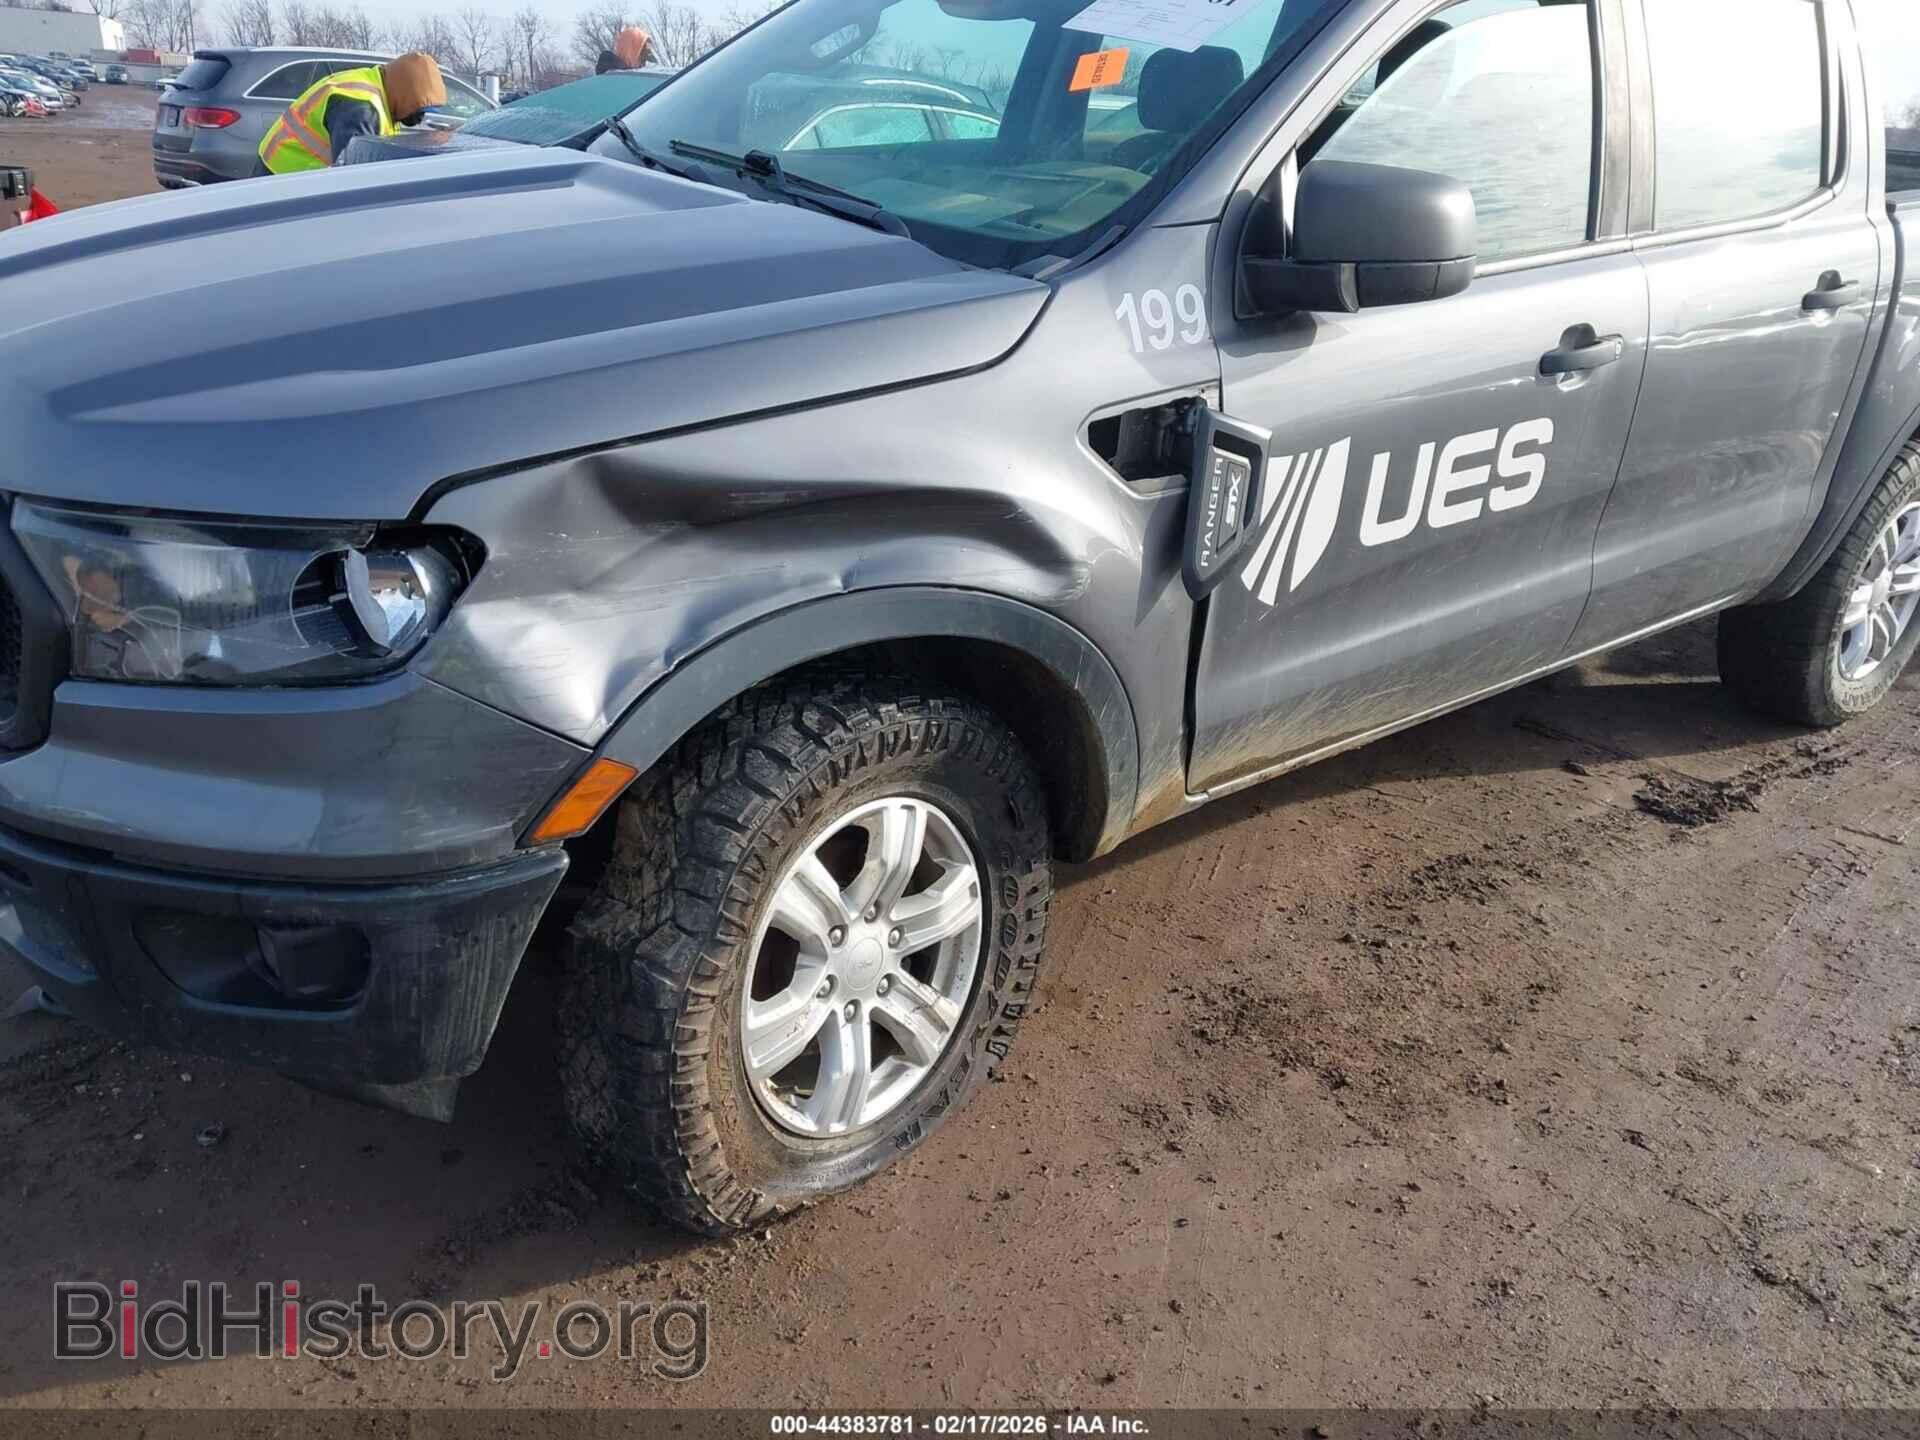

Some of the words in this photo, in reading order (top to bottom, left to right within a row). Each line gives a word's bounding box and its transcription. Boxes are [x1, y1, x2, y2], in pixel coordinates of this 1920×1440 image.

[1114, 283, 1206, 353] 199
[1200, 457, 1224, 567] RANGER
[1359, 417, 1554, 546] UES
